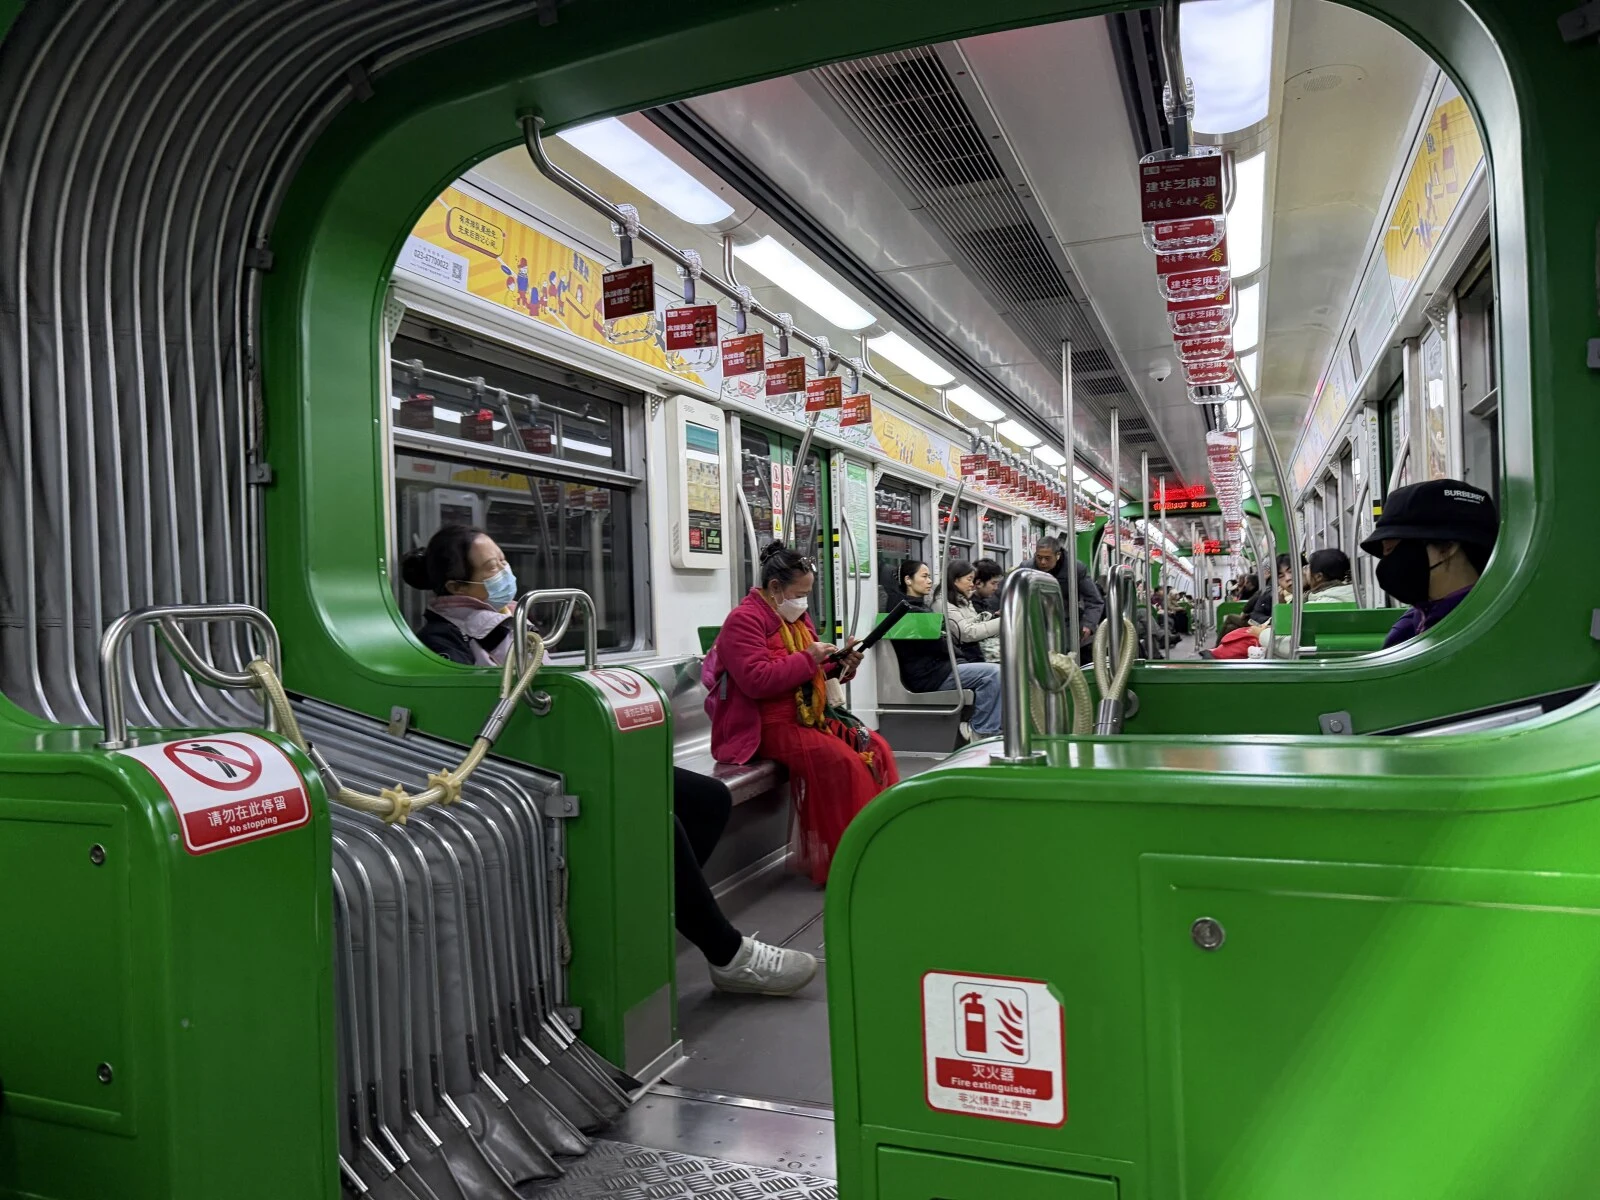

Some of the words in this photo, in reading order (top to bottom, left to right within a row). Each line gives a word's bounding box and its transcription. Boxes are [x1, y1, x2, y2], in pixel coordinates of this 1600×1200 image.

[1145, 176, 1217, 193] 建华芝麻油
[1444, 489, 1485, 502] BURBERRY
[208, 796, 287, 827] 请勿在此停留
[229, 825, 242, 834] No
[242, 816, 278, 831] stopping
[972, 1063, 1015, 1082] 灭火器
[951, 1077, 971, 1087] Fire
[972, 1081, 1037, 1096] extinguisher
